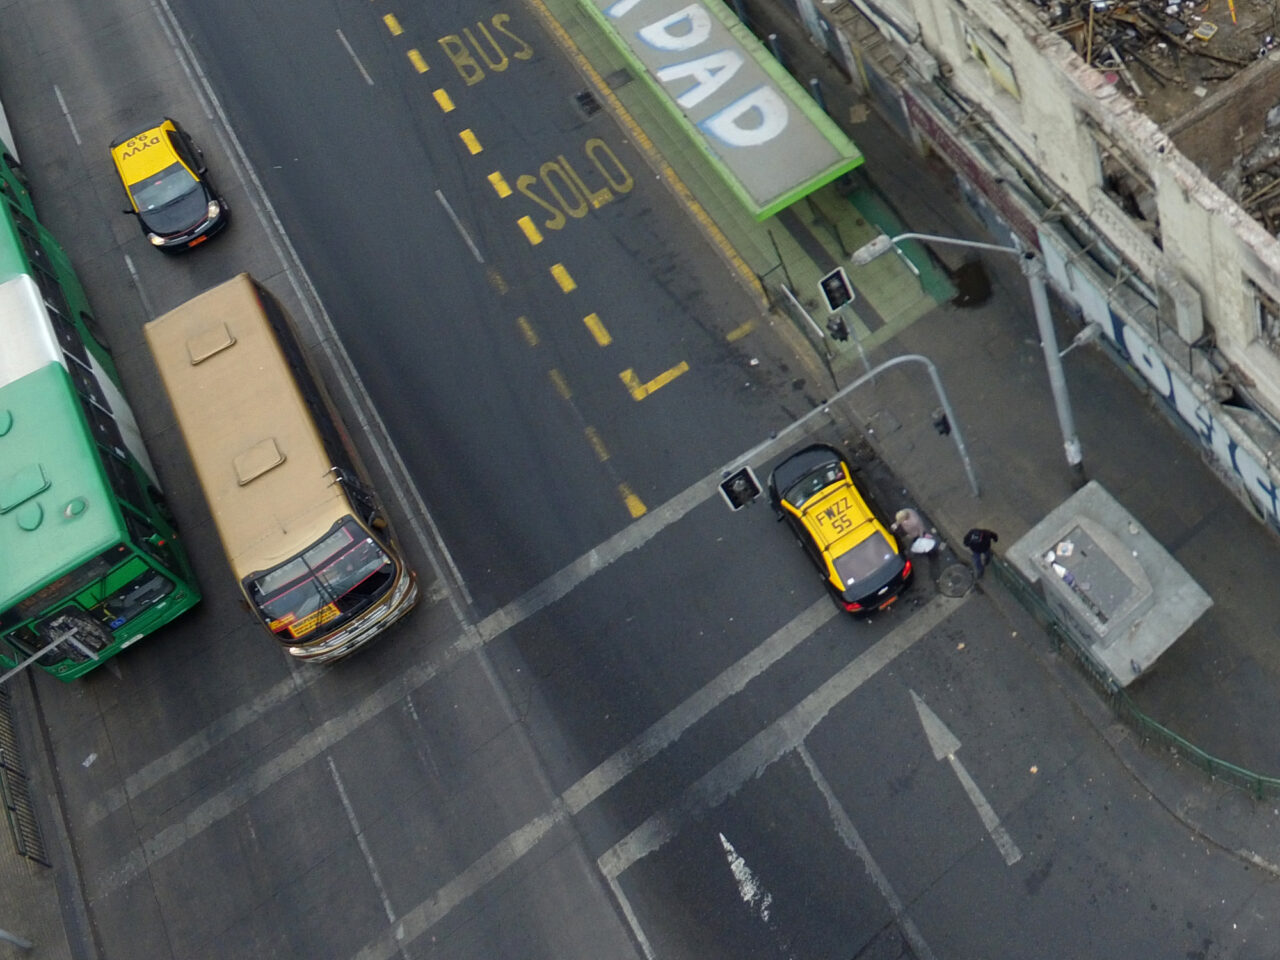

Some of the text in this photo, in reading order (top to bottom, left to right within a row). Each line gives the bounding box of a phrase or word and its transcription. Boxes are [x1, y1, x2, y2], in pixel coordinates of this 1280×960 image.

[437, 12, 534, 86] BUS
[121, 136, 161, 161] DYVV
[516, 137, 636, 232] SOLO
[815, 496, 853, 527] FWZZ
[831, 514, 853, 535] 55
